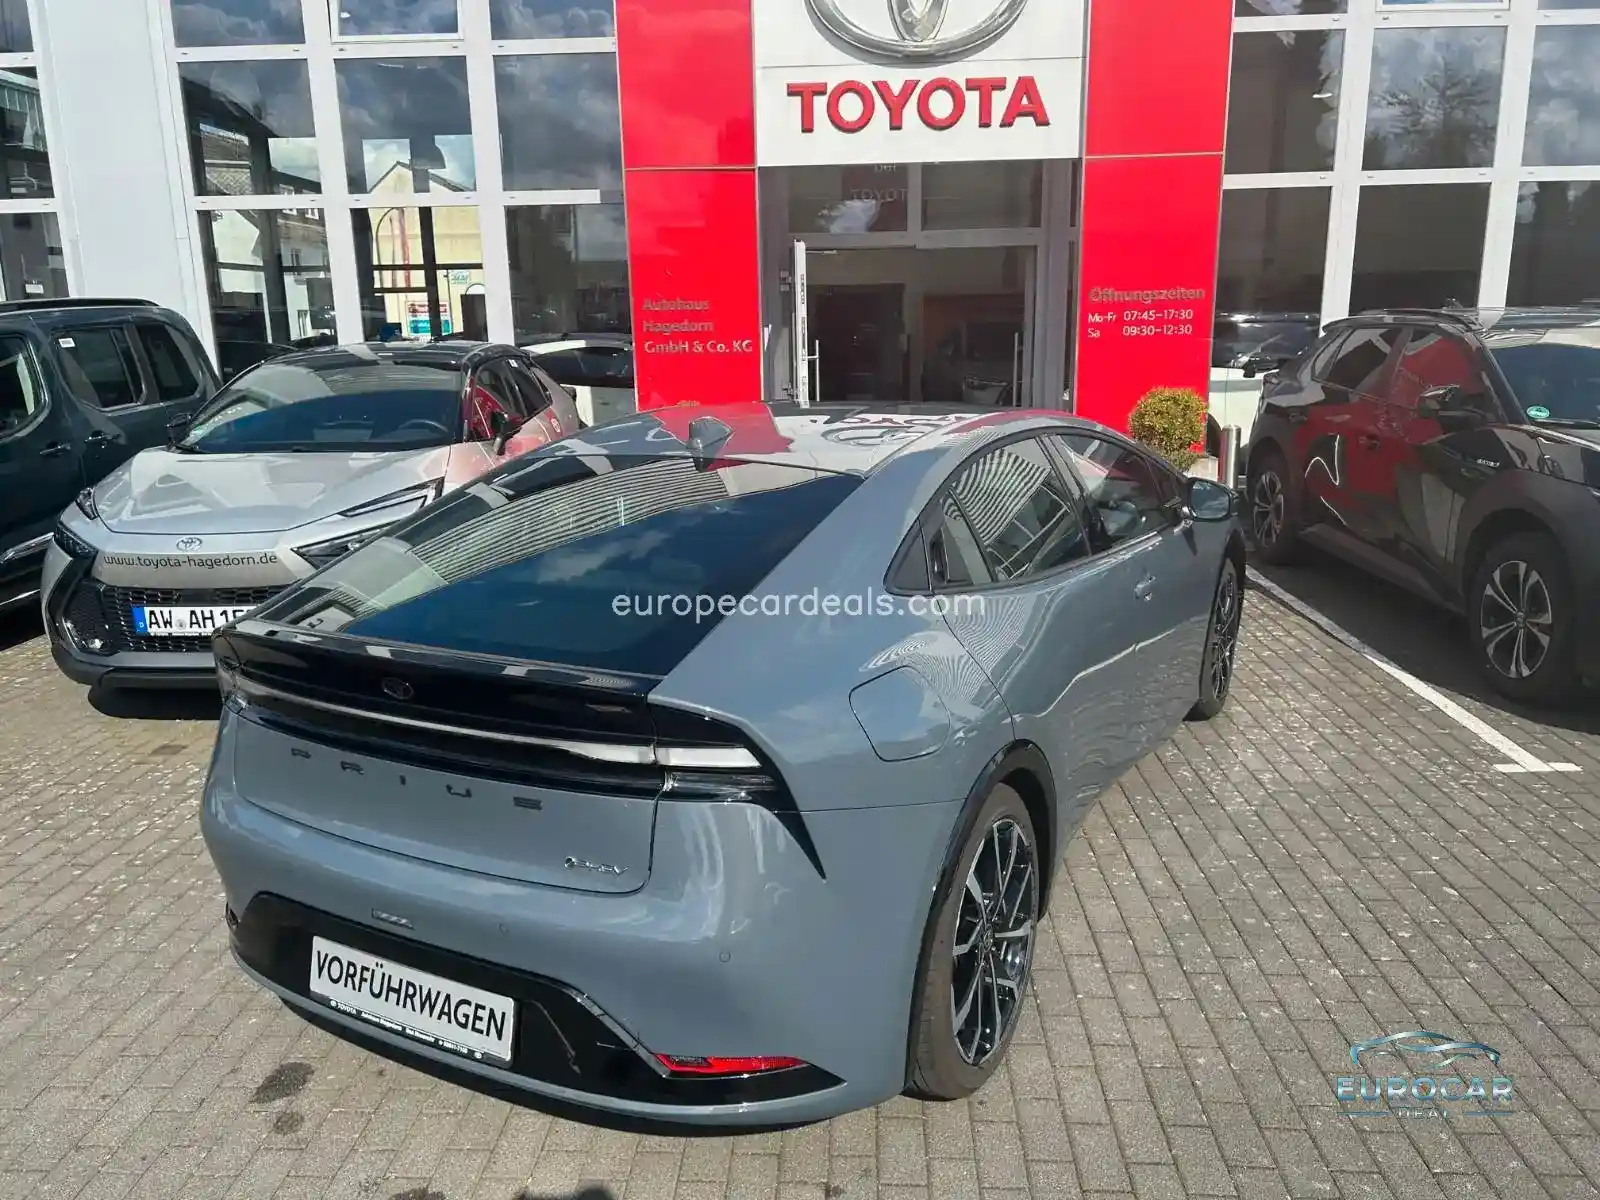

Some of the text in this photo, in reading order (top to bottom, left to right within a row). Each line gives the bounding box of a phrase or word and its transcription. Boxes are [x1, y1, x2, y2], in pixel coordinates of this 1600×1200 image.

[787, 76, 1051, 134] TOYOTA
[643, 297, 709, 310] Autohaus
[1087, 286, 1205, 304] Öffnungszeiten
[1088, 312, 1117, 323] Mo-Fr
[642, 320, 714, 335] Hagedorn
[1087, 328, 1101, 338] Sa
[644, 339, 753, 353] GmbH & Co. KG
[103, 553, 278, 570] www.toyota-hagedorn.de
[148, 609, 173, 629] AW
[189, 609, 216, 629] AH
[291, 748, 543, 810] PRIUS
[316, 950, 507, 1042] VORFÜHRWAGEN
